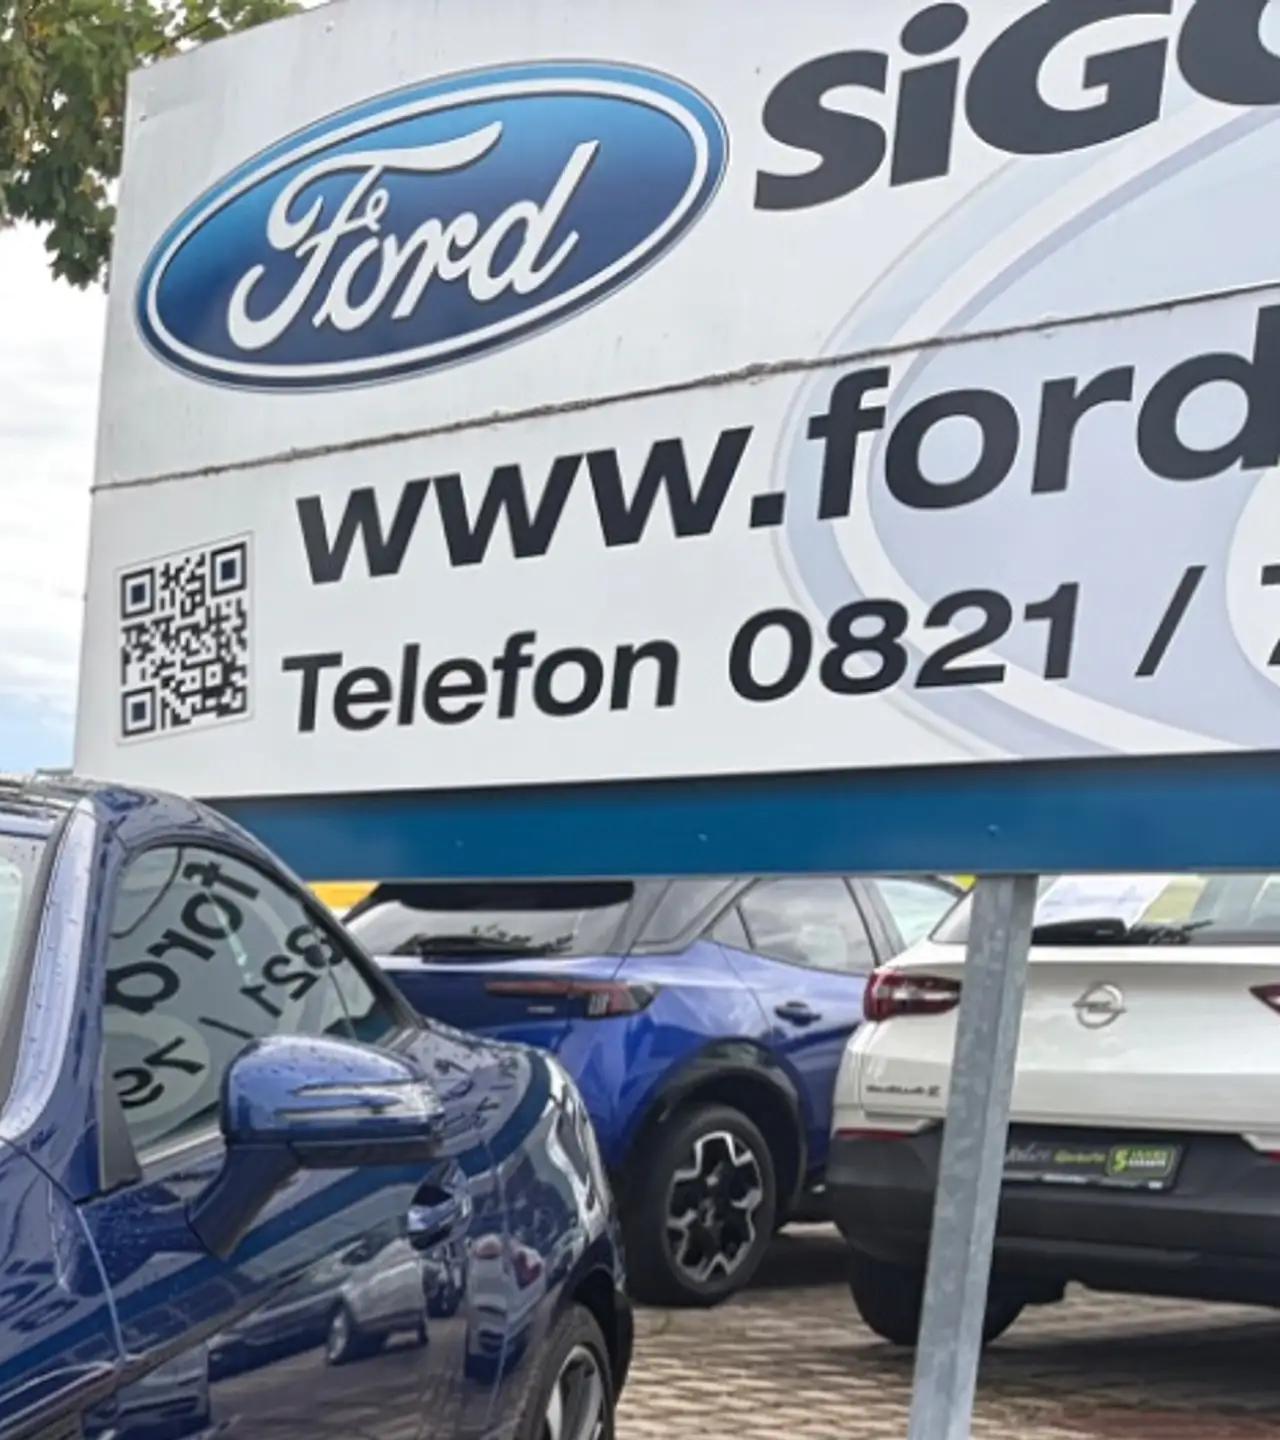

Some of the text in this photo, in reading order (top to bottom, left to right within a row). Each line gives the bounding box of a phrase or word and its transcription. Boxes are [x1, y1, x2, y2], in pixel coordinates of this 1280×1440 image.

[227, 120, 600, 351] Ford
[295, 303, 1280, 586] www.ford
[282, 630, 680, 733] Telefon
[728, 580, 1080, 702] 0821
[1134, 564, 1207, 678] /
